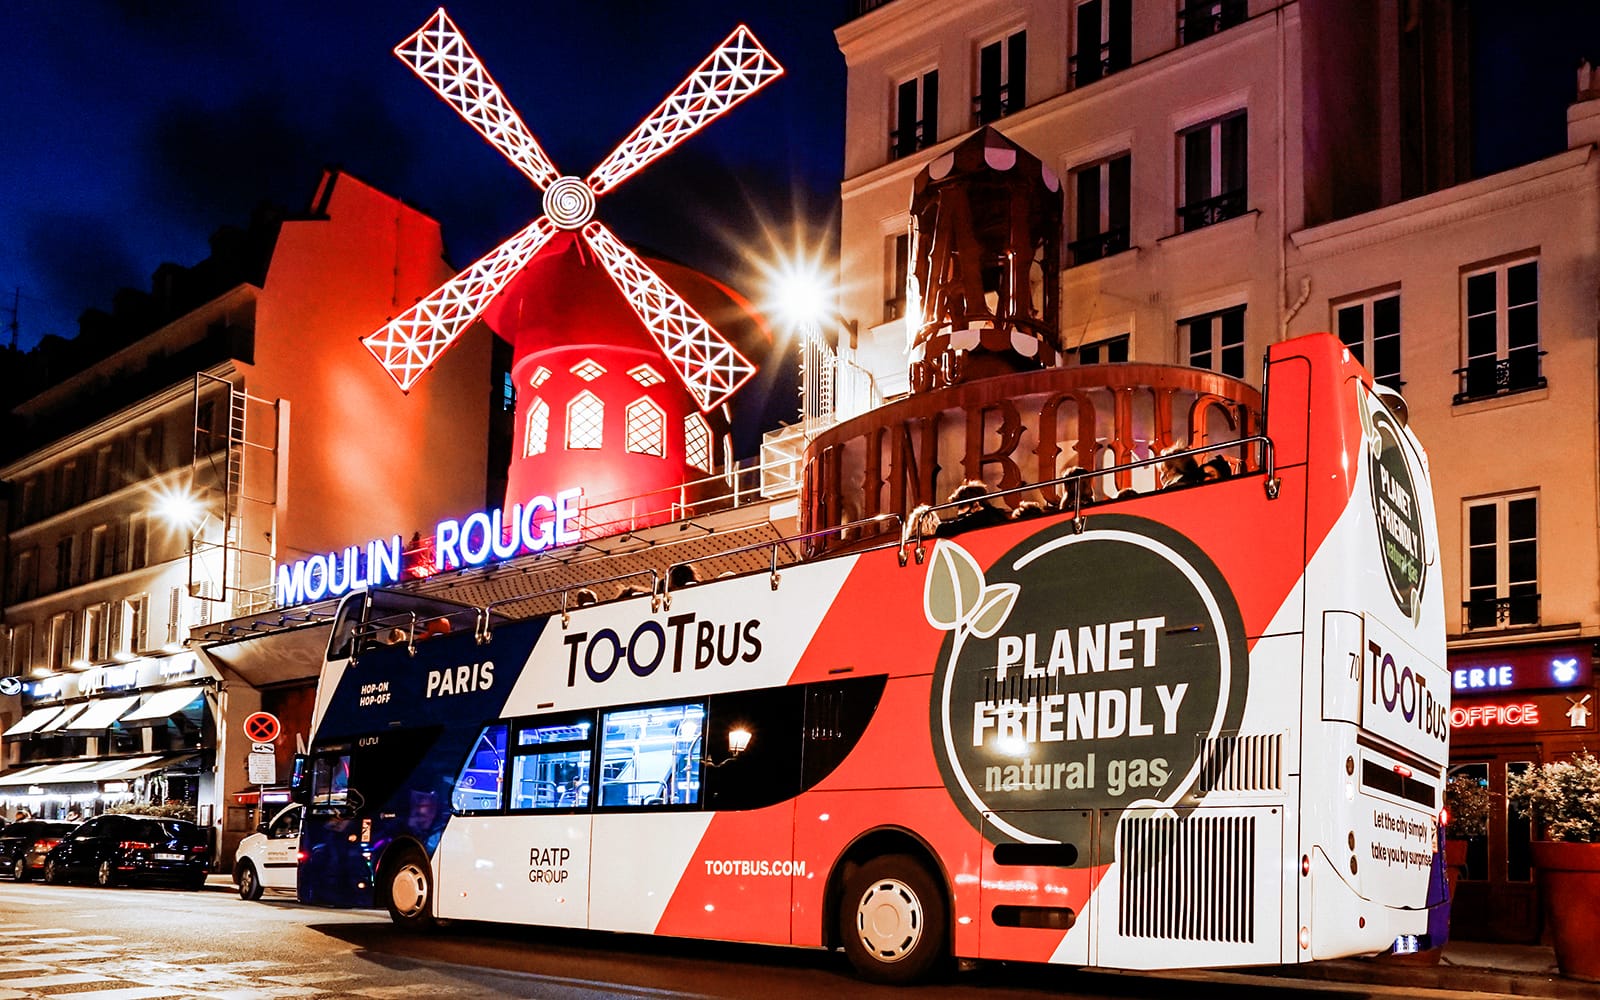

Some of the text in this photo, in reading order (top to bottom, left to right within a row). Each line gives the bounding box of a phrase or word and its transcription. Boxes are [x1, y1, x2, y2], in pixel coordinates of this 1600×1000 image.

[1380, 463, 1412, 521] PLANET
[1379, 496, 1418, 560] FRIENDLY
[278, 487, 582, 607] MOULIN ROUGE
[996, 616, 1166, 682] PLANET
[361, 682, 389, 695] HOP-ON
[426, 661, 495, 699] PARIS
[1454, 665, 1513, 689] ERIE
[360, 693, 391, 706] HOP-OFF
[972, 683, 1189, 747] FRIENDLY
[1450, 703, 1539, 728] OFFICE
[985, 754, 1170, 796] natural gas
[1373, 810, 1428, 844] Let the city simply
[529, 848, 570, 866] RATP
[705, 860, 806, 876] TOOTBUS.COM
[1371, 842, 1432, 871] take you by surprise
[528, 869, 569, 884] GROUP
